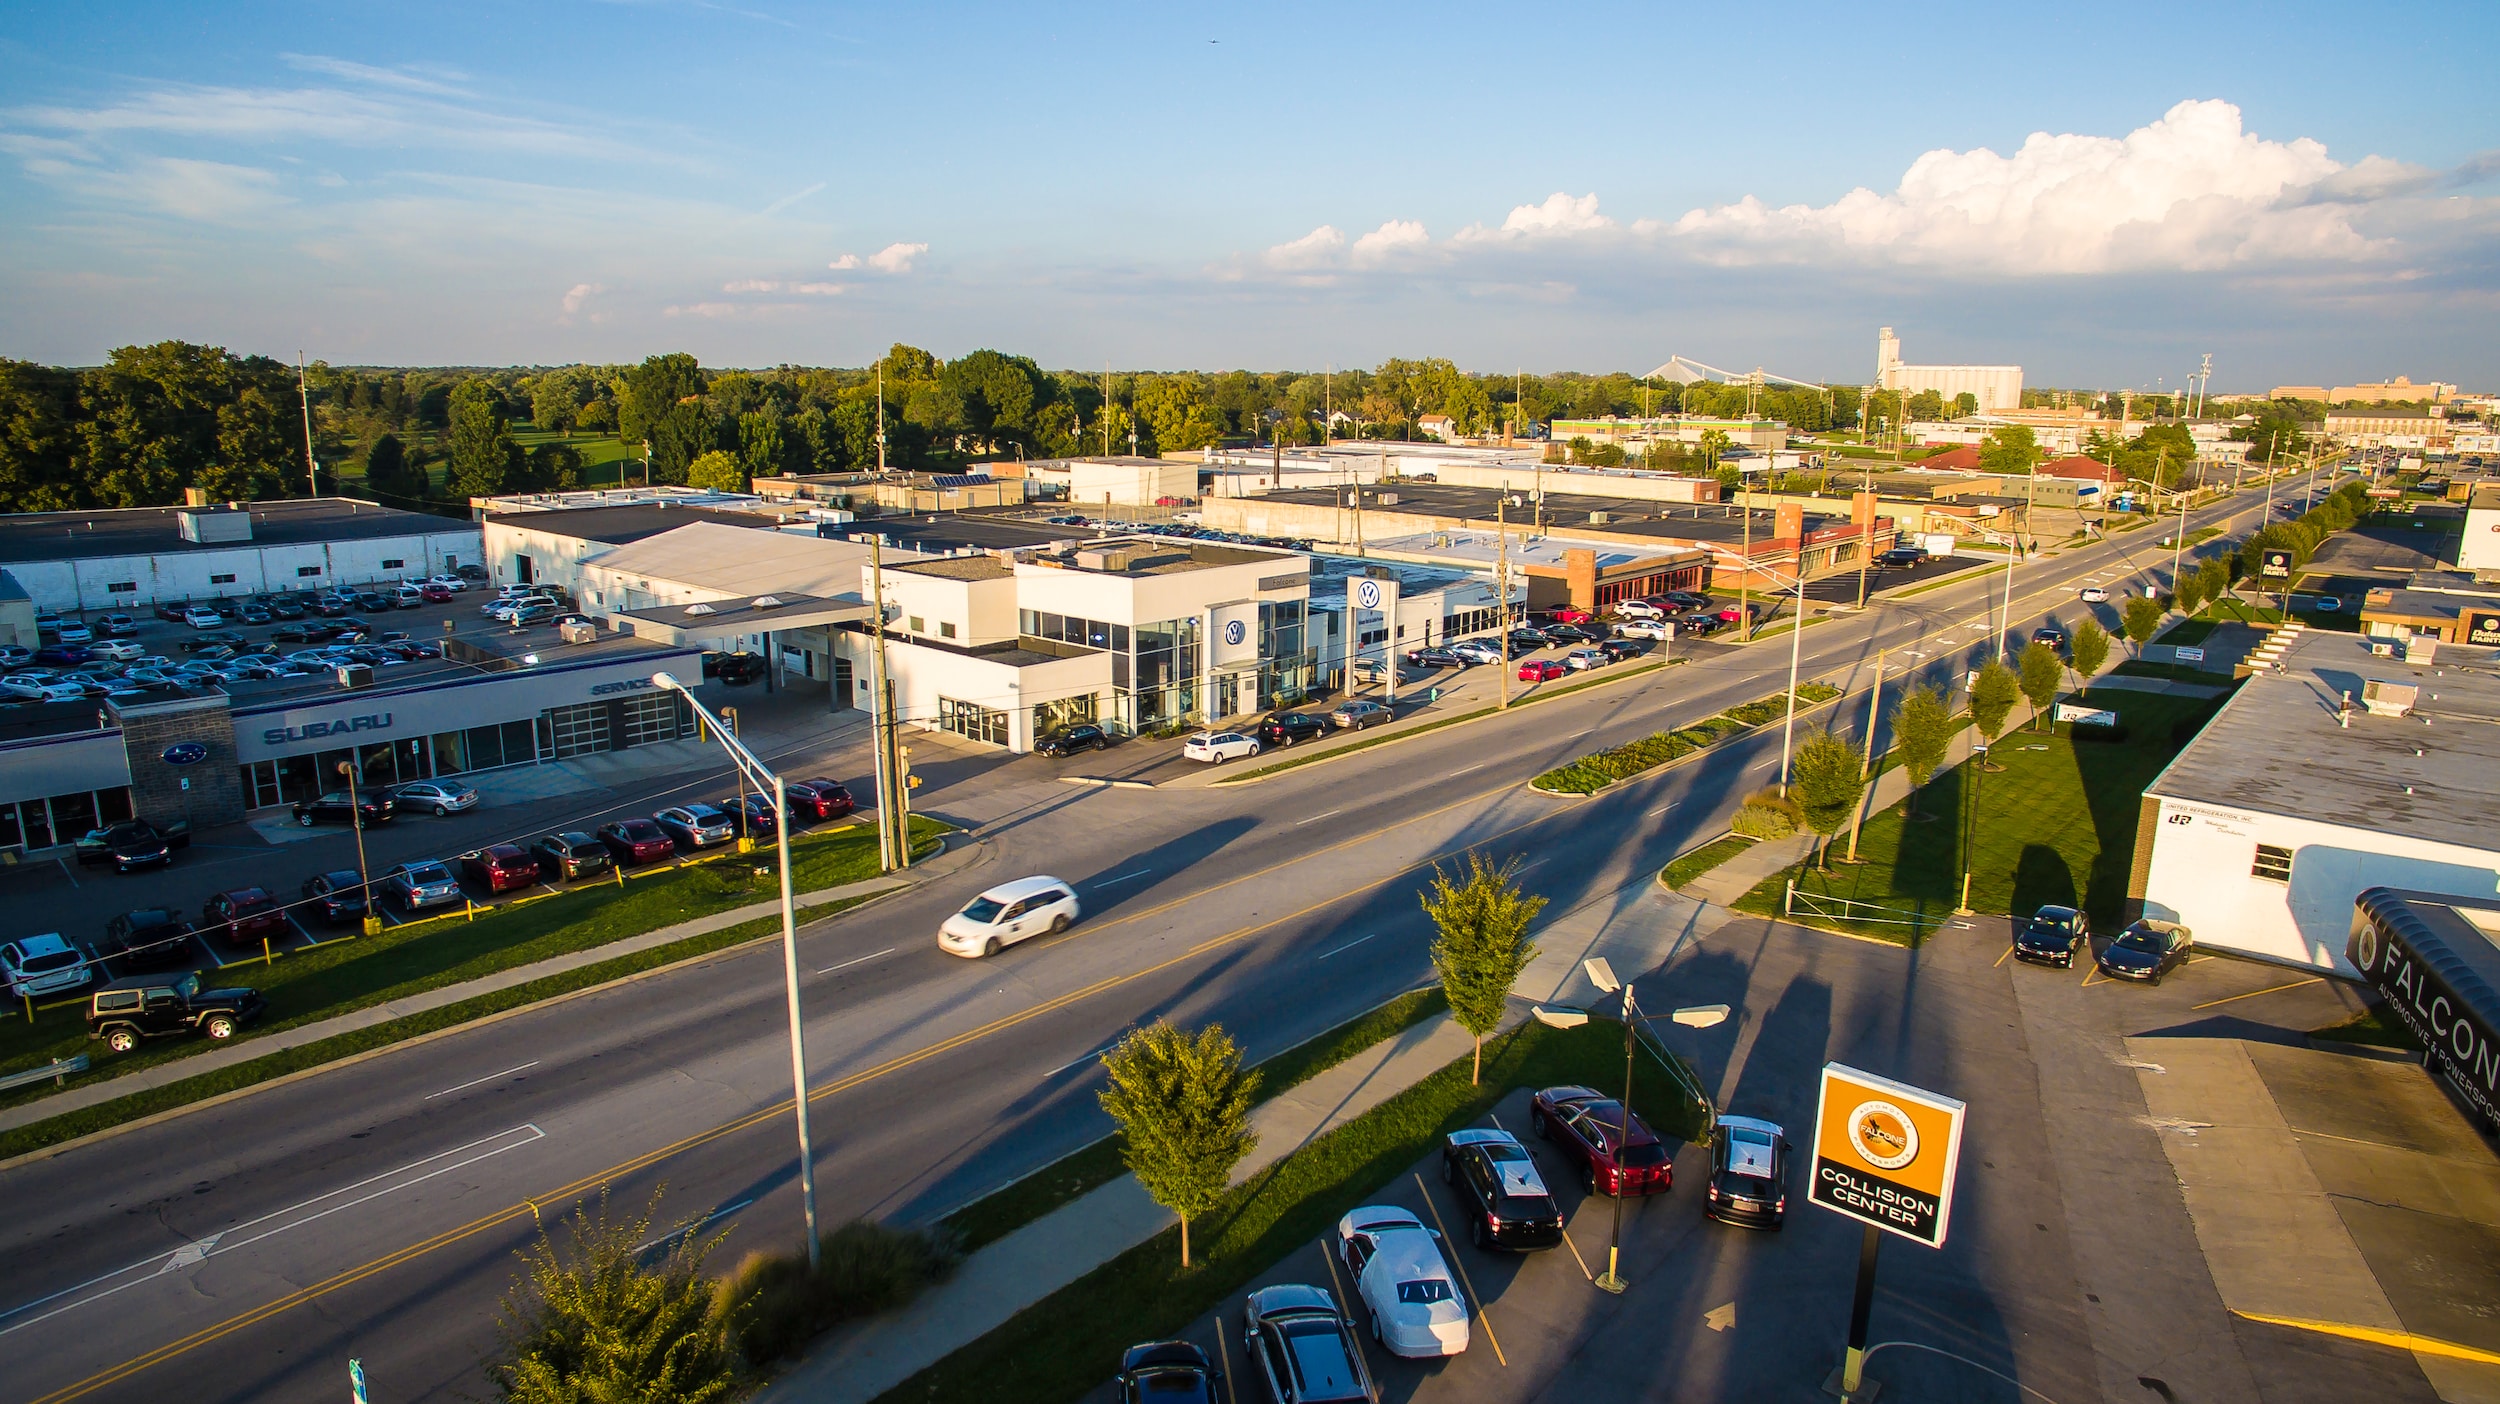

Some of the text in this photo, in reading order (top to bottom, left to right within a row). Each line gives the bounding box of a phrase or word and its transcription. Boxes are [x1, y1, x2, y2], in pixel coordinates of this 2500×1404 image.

[1272, 577, 1296, 586] Falcone
[591, 677, 653, 696] SERVICE
[264, 712, 392, 746] SUBARU
[2165, 803, 2188, 811] UNITED
[2378, 982, 2430, 1047] AUTOMOTIVE
[2430, 1040, 2437, 1054] &
[1859, 1104, 1911, 1130] AUTOMOTIVE
[1860, 1124, 1906, 1146] FALCONE
[1853, 1136, 1911, 1166] POWERSPORTS
[1821, 1167, 1934, 1217] COLLISION
[1833, 1187, 1917, 1227] CENTER
